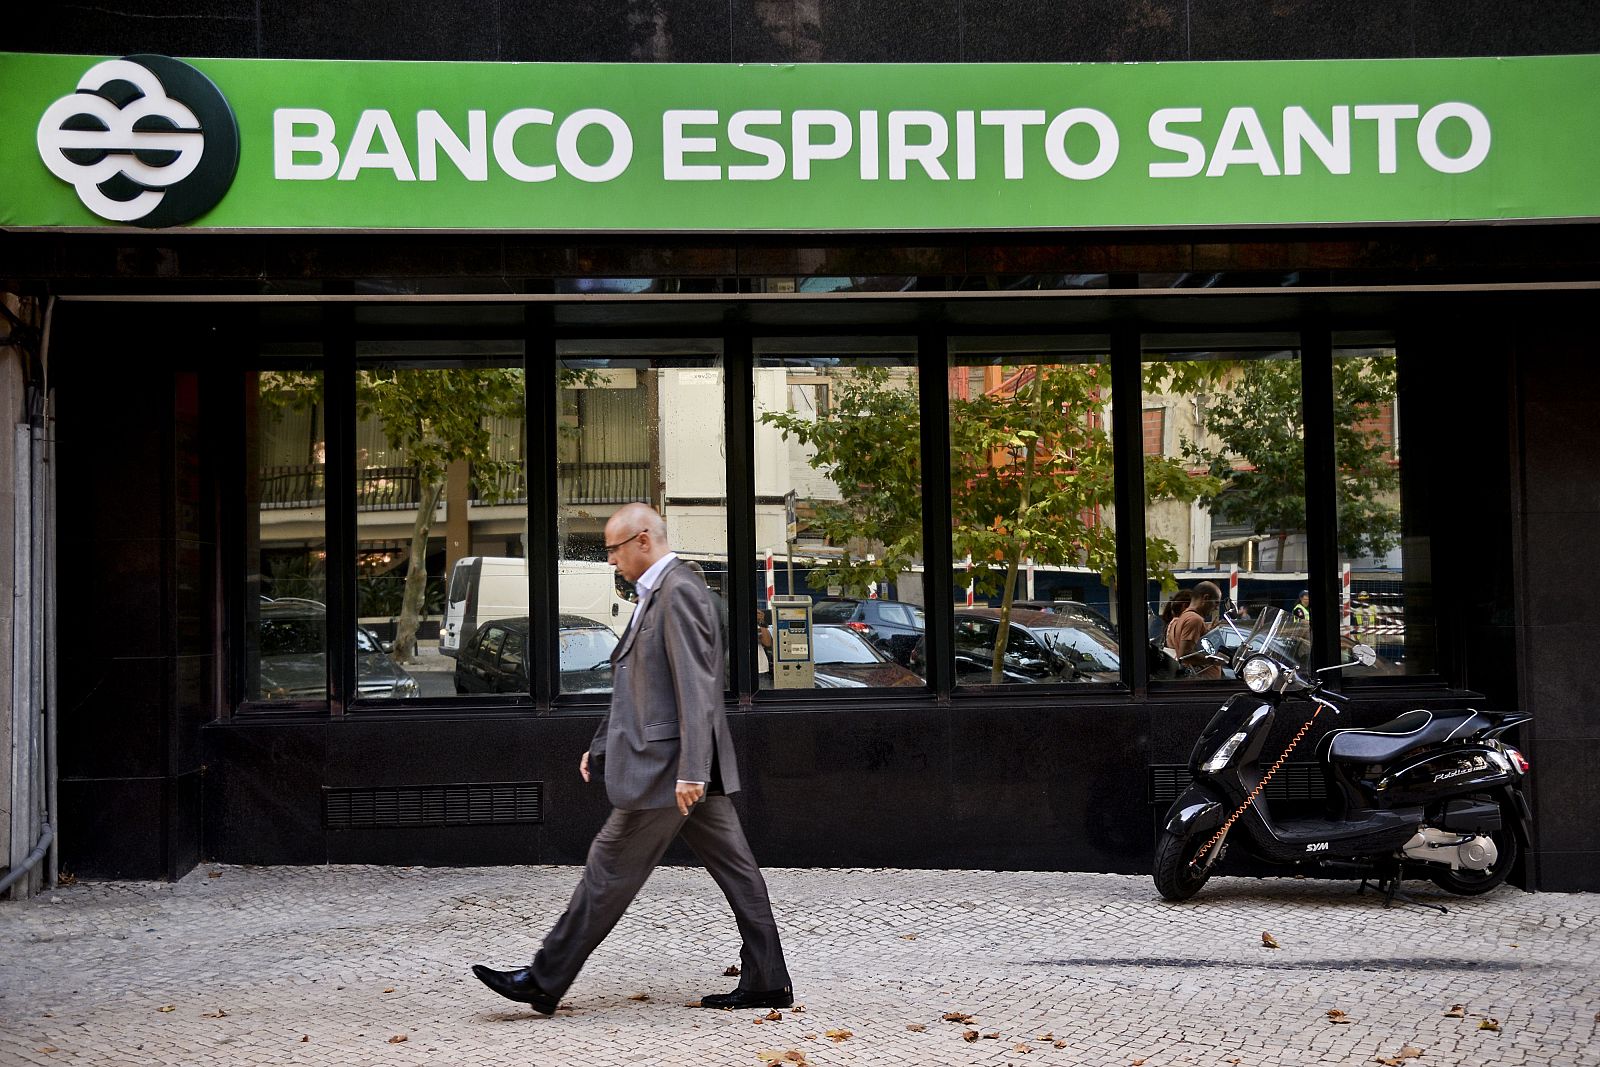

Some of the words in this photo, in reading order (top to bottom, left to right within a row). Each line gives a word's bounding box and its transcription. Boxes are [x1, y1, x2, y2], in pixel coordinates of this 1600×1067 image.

[273, 107, 634, 183] BANCO
[662, 107, 1120, 182] ESPIRITO
[1148, 101, 1491, 178] SANTO
[1306, 842, 1329, 851] SYM
